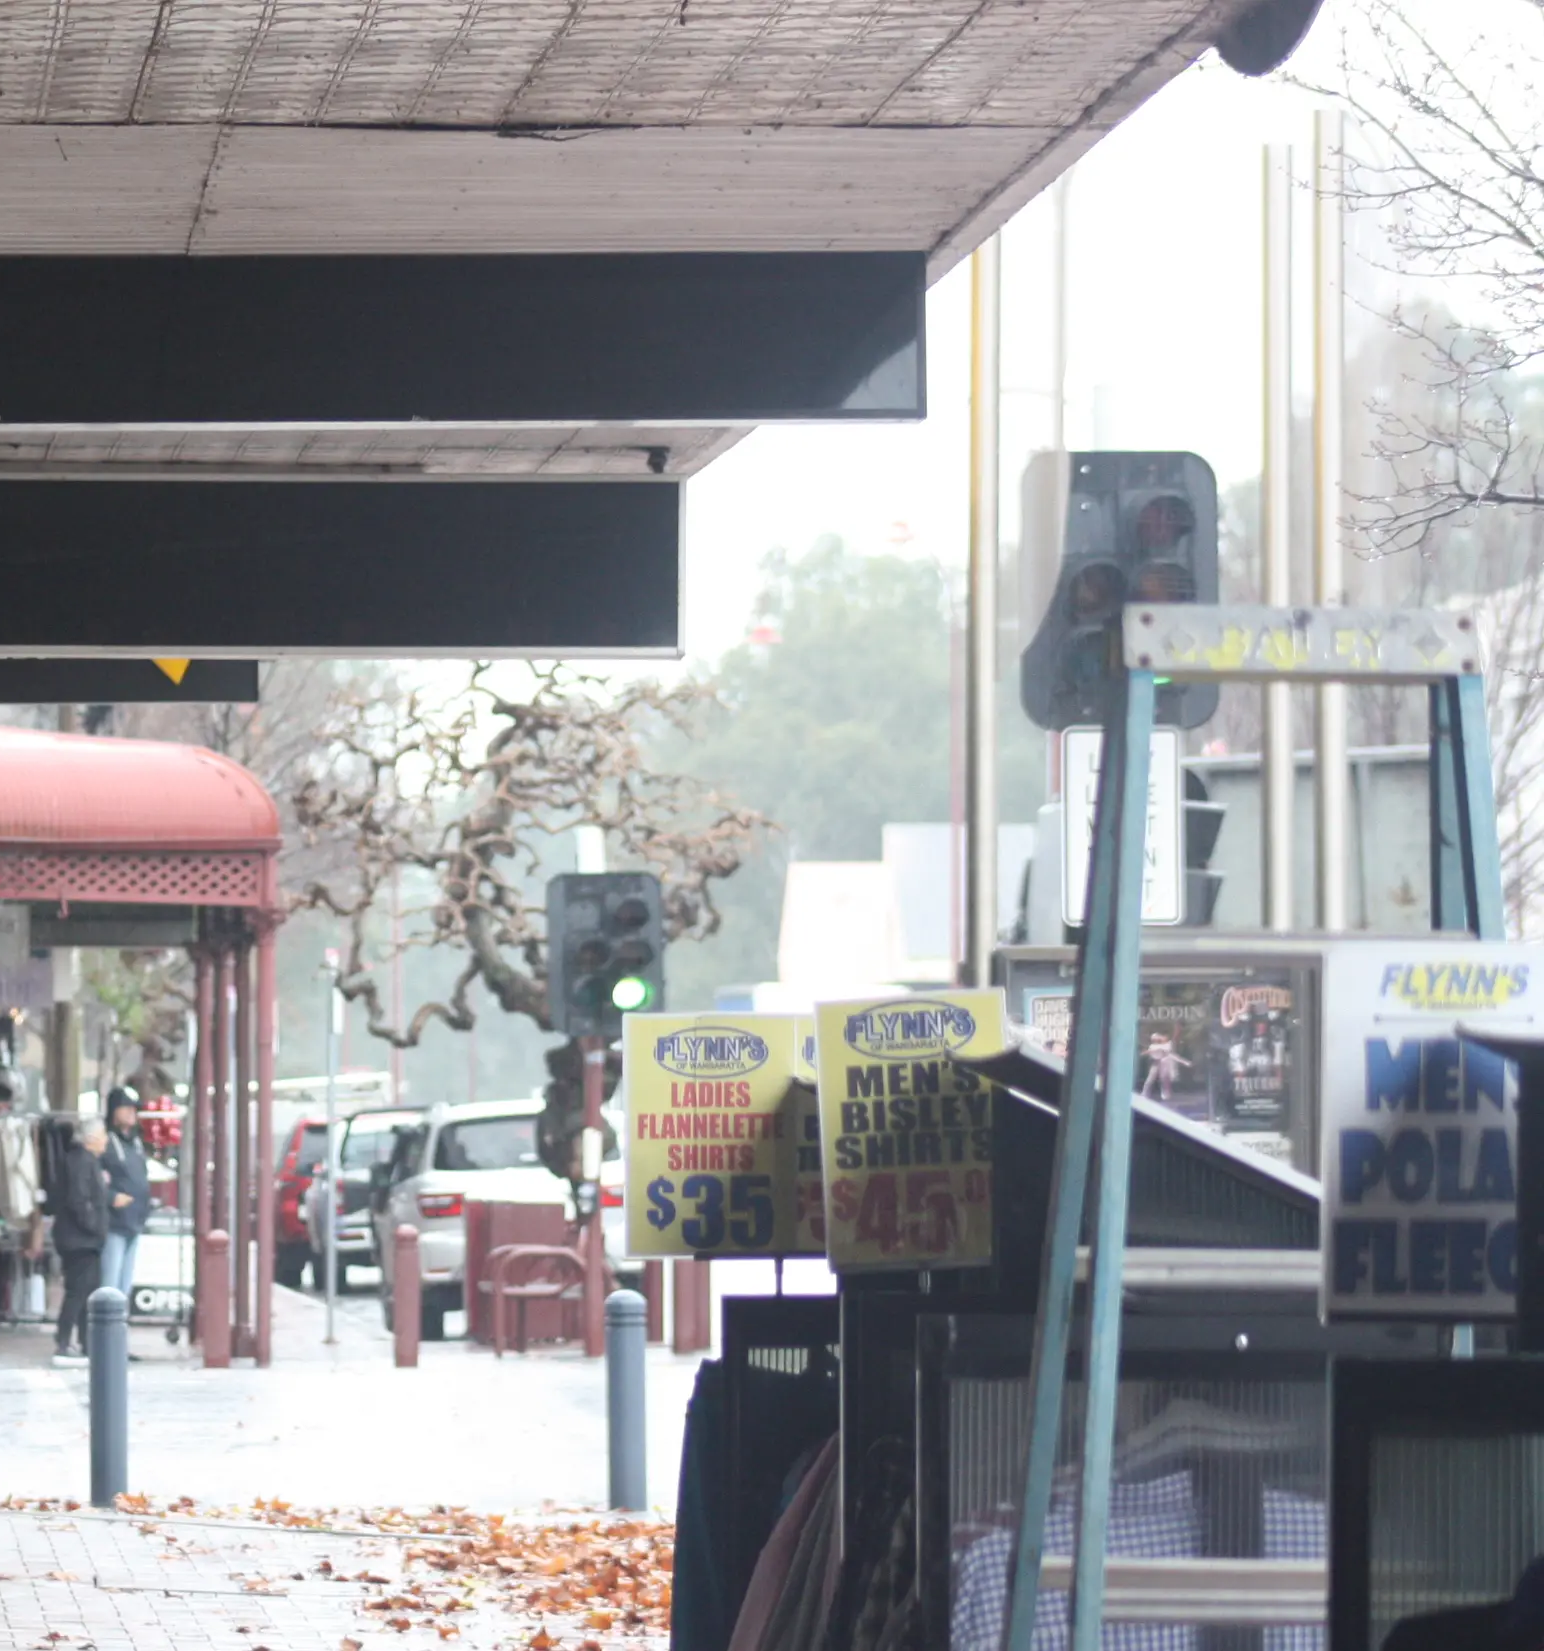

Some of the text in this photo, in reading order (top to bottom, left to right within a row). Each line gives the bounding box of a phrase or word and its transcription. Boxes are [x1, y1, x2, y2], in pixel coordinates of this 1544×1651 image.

[1379, 962, 1531, 998] FLYNN'S
[845, 1006, 973, 1043] FLYNN'S
[1138, 1006, 1205, 1021] LADDIN
[656, 1035, 765, 1062] FLYNN'S
[670, 1080, 751, 1109] LADIES
[845, 1060, 981, 1099] MEN'S
[1364, 1036, 1518, 1114] MEN
[840, 1094, 991, 1134] BISLEY
[667, 1143, 755, 1172] SHIRTS
[835, 1128, 992, 1170] SHIRTS
[1339, 1126, 1517, 1207] POLA
[646, 1173, 775, 1249] $35
[1332, 1217, 1519, 1295] FLEEC
